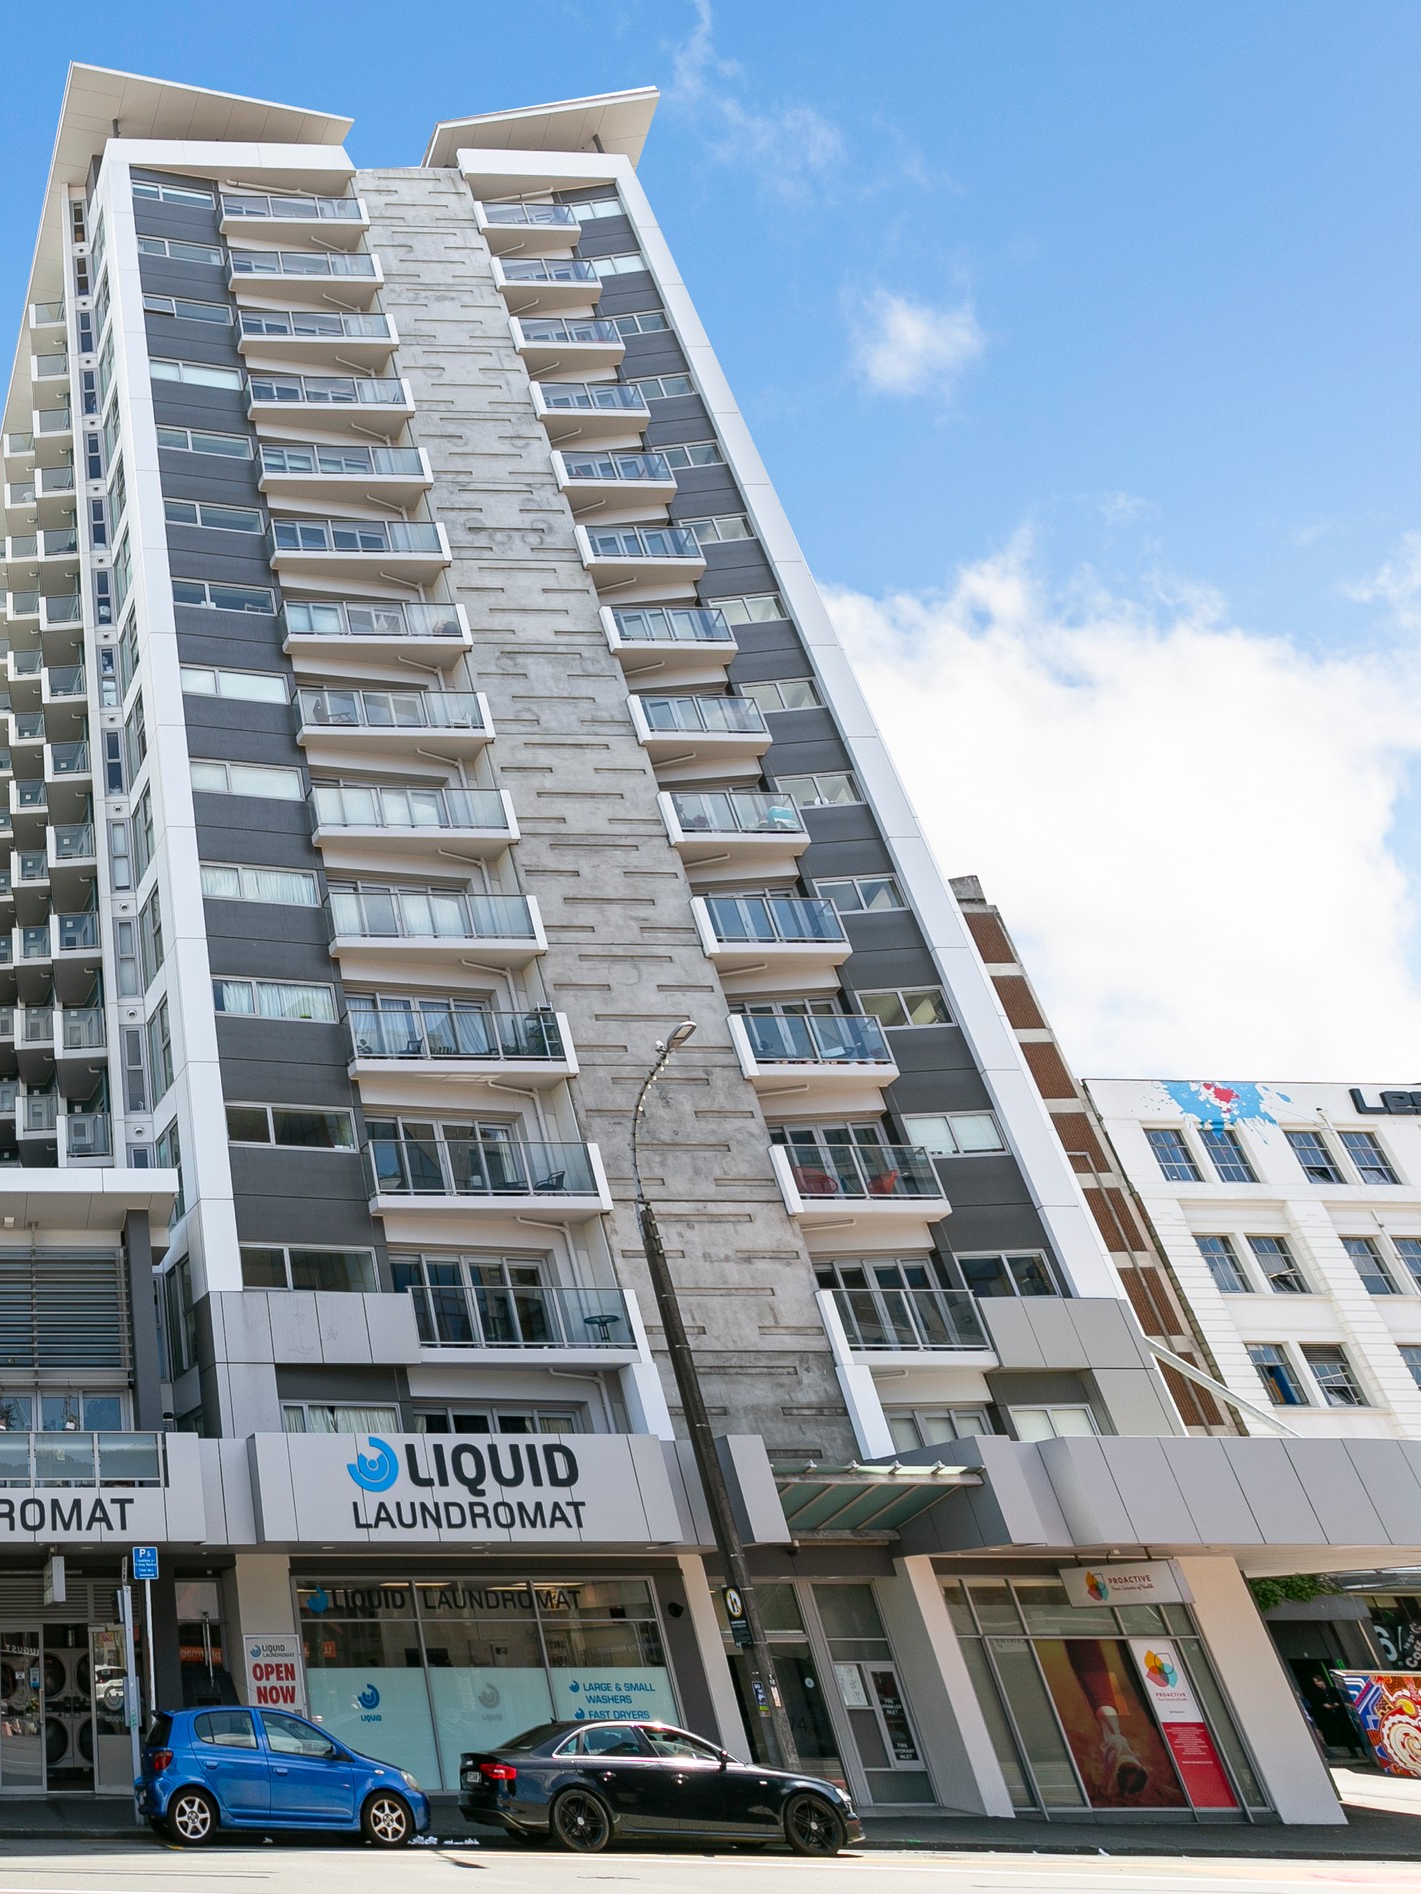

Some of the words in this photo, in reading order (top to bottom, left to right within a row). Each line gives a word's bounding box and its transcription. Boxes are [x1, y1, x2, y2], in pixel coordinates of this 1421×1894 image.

[1349, 1088, 1421, 1115] Le
[405, 1444, 579, 1497] LIQUID
[352, 1501, 586, 1529] LAUNDROMAT
[1108, 1575, 1151, 1584] PROACTIVE
[332, 1589, 405, 1610] LIQUID
[424, 1589, 580, 1610] LAUNDROMAT
[252, 1663, 296, 1681] OPEN
[256, 1685, 296, 1704] NOW
[583, 1683, 612, 1691] LARGE
[615, 1683, 621, 1691] &
[623, 1683, 655, 1691] SMALL
[586, 1695, 632, 1703] WASHERS
[589, 1711, 610, 1719] FAST
[613, 1711, 650, 1719] DRYERS
